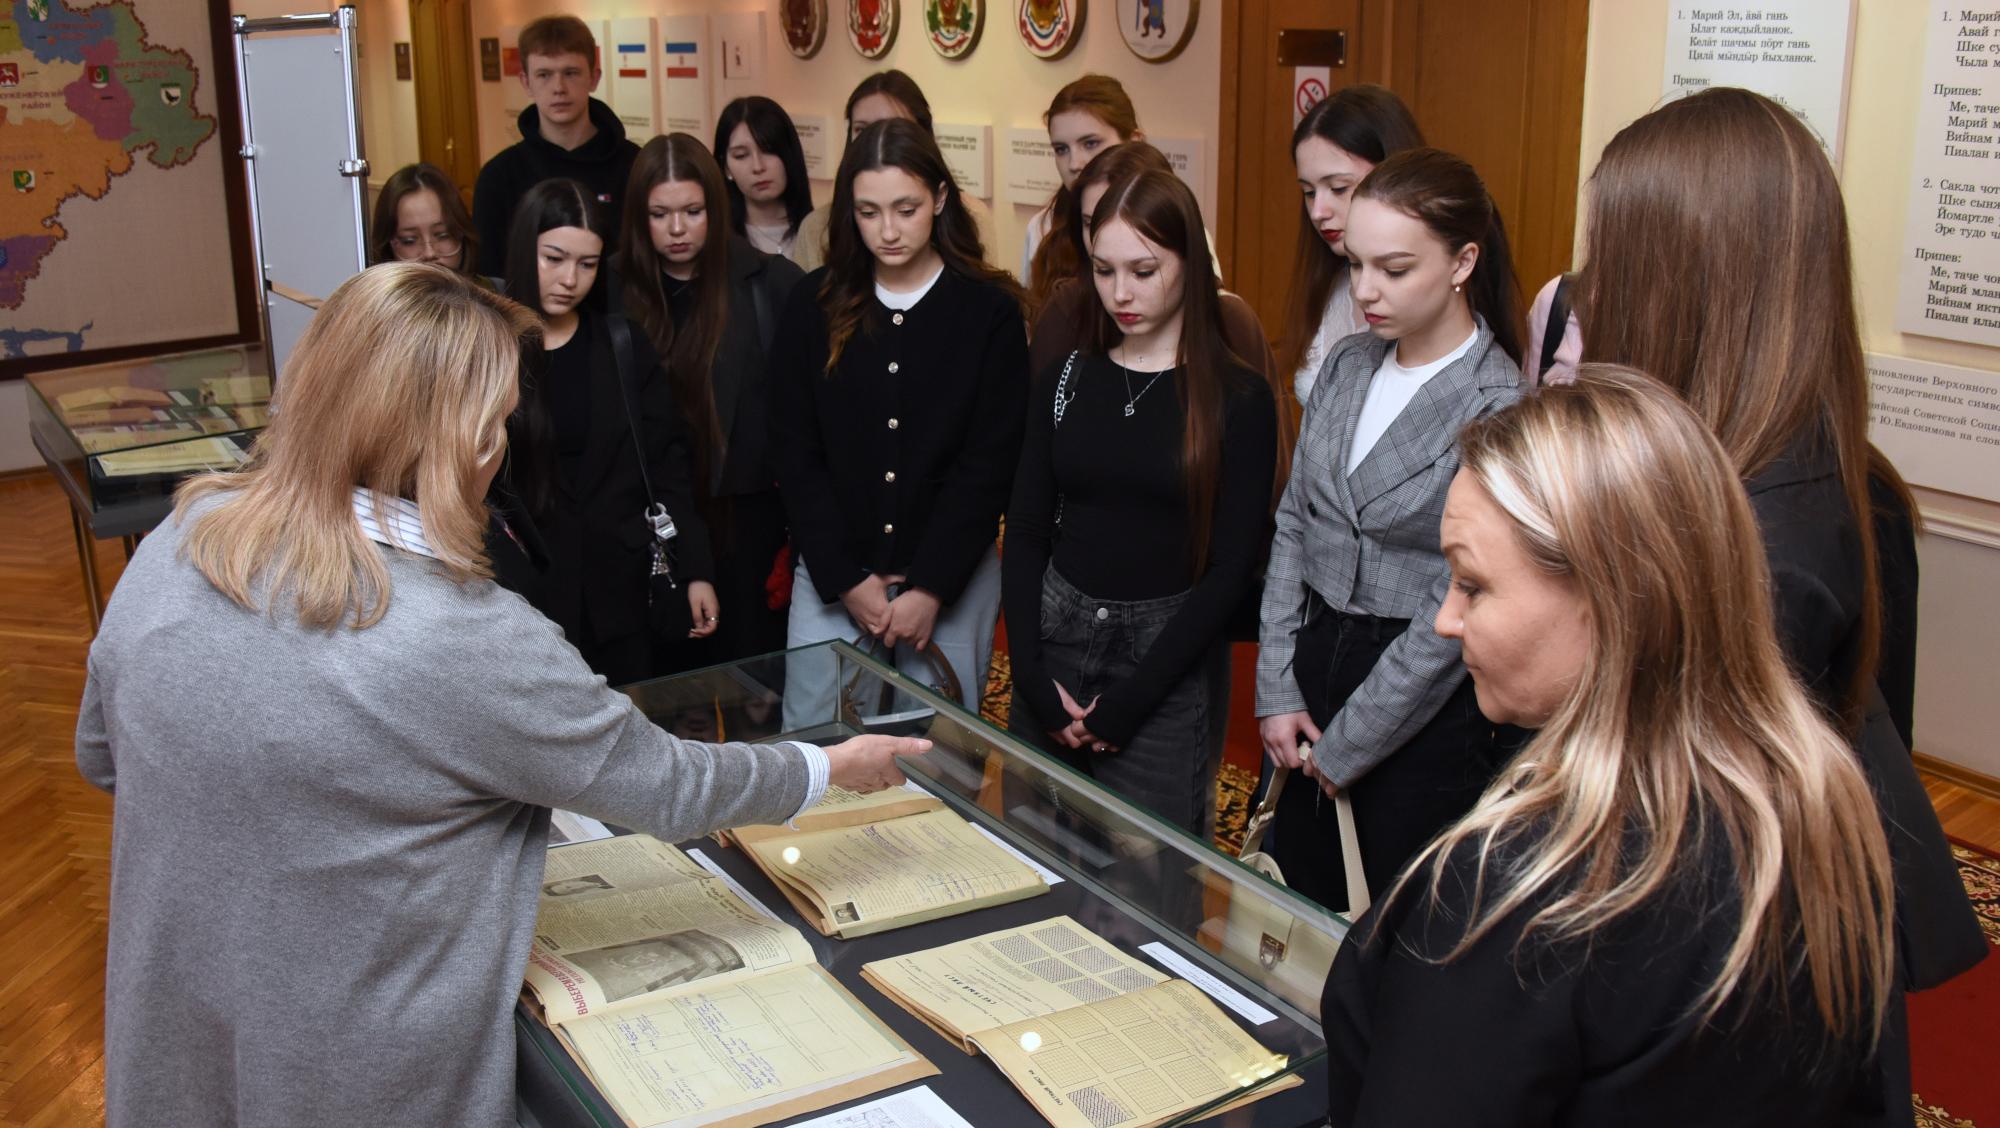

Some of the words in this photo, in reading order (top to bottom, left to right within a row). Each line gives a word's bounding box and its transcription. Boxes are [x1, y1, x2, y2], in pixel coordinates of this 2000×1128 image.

[1691, 9, 1724, 22] Марий
[1727, 10, 1743, 21] Эл,
[1766, 12, 1789, 20] гань
[1943, 11, 1952, 22] 1.
[1690, 24, 1716, 34] Ылат
[1958, 26, 1989, 37] Авай
[1787, 41, 1811, 49] гань
[1956, 41, 1985, 52] Шке
[1955, 56, 1989, 68] Чыла
[1673, 74, 1711, 87] Припев:
[1933, 83, 1983, 97] Припев:
[1949, 101, 1970, 113] Ме,
[1947, 116, 1988, 130] Марий
[1946, 130, 1993, 144] Вийнам
[1944, 145, 1989, 159] Пиалан
[1922, 177, 1933, 189] 2.
[1940, 179, 1976, 193] Сакла
[1938, 193, 1967, 207] Шке
[1937, 206, 1995, 225] Йомартле
[1935, 223, 1956, 236] Эре
[1960, 228, 1986, 239] тудо
[1915, 248, 1962, 264] Припев:
[1930, 265, 1951, 279] Ме,
[1954, 270, 1980, 282] таче
[1928, 280, 1968, 295] Марий
[1927, 294, 1972, 310] Вийнам
[1925, 308, 1969, 324] Пиалан
[1867, 368, 1929, 384] тановление
[1932, 375, 1998, 396] Верховного
[1870, 382, 1964, 405] государственных
[1913, 408, 1967, 426] Советской
[1879, 415, 1956, 438] Ю.Евдокимова
[1960, 432, 1972, 441] на
